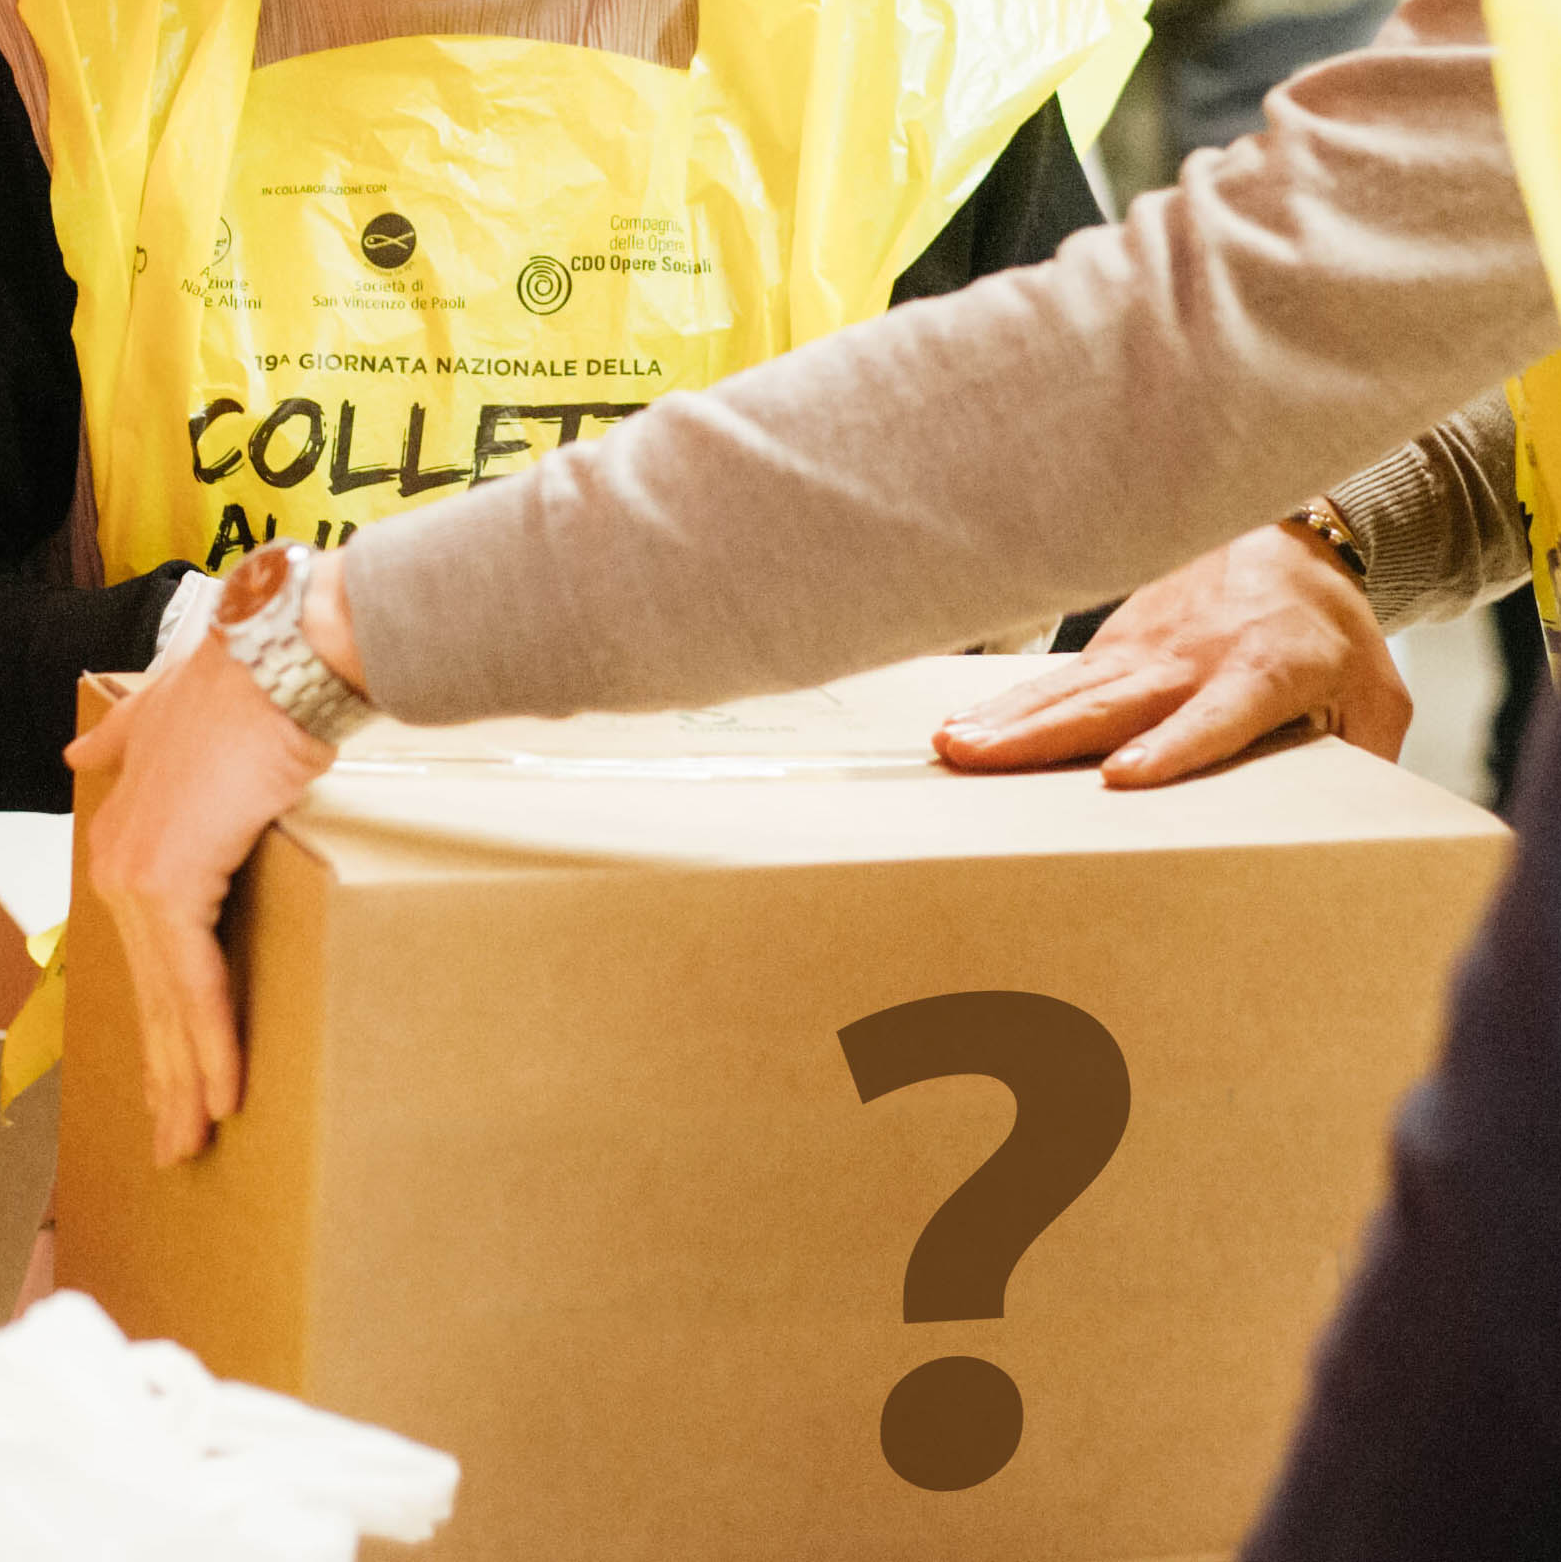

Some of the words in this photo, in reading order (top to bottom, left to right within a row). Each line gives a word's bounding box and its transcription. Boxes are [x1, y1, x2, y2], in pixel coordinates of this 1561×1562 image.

[261, 187, 272, 196] IN
[365, 184, 387, 194] CON
[570, 255, 606, 271] CDO
[610, 254, 656, 274] Opere
[354, 279, 405, 294] Società
[412, 279, 424, 292] di
[218, 294, 262, 311] Alpini
[312, 295, 337, 307] San
[343, 296, 405, 310] Vincenzo
[411, 296, 426, 310] de
[431, 295, 465, 310] Paoli
[299, 352, 427, 374] GIORNATA
[437, 356, 577, 377] NAZIONALE
[586, 358, 662, 377] DELLA
